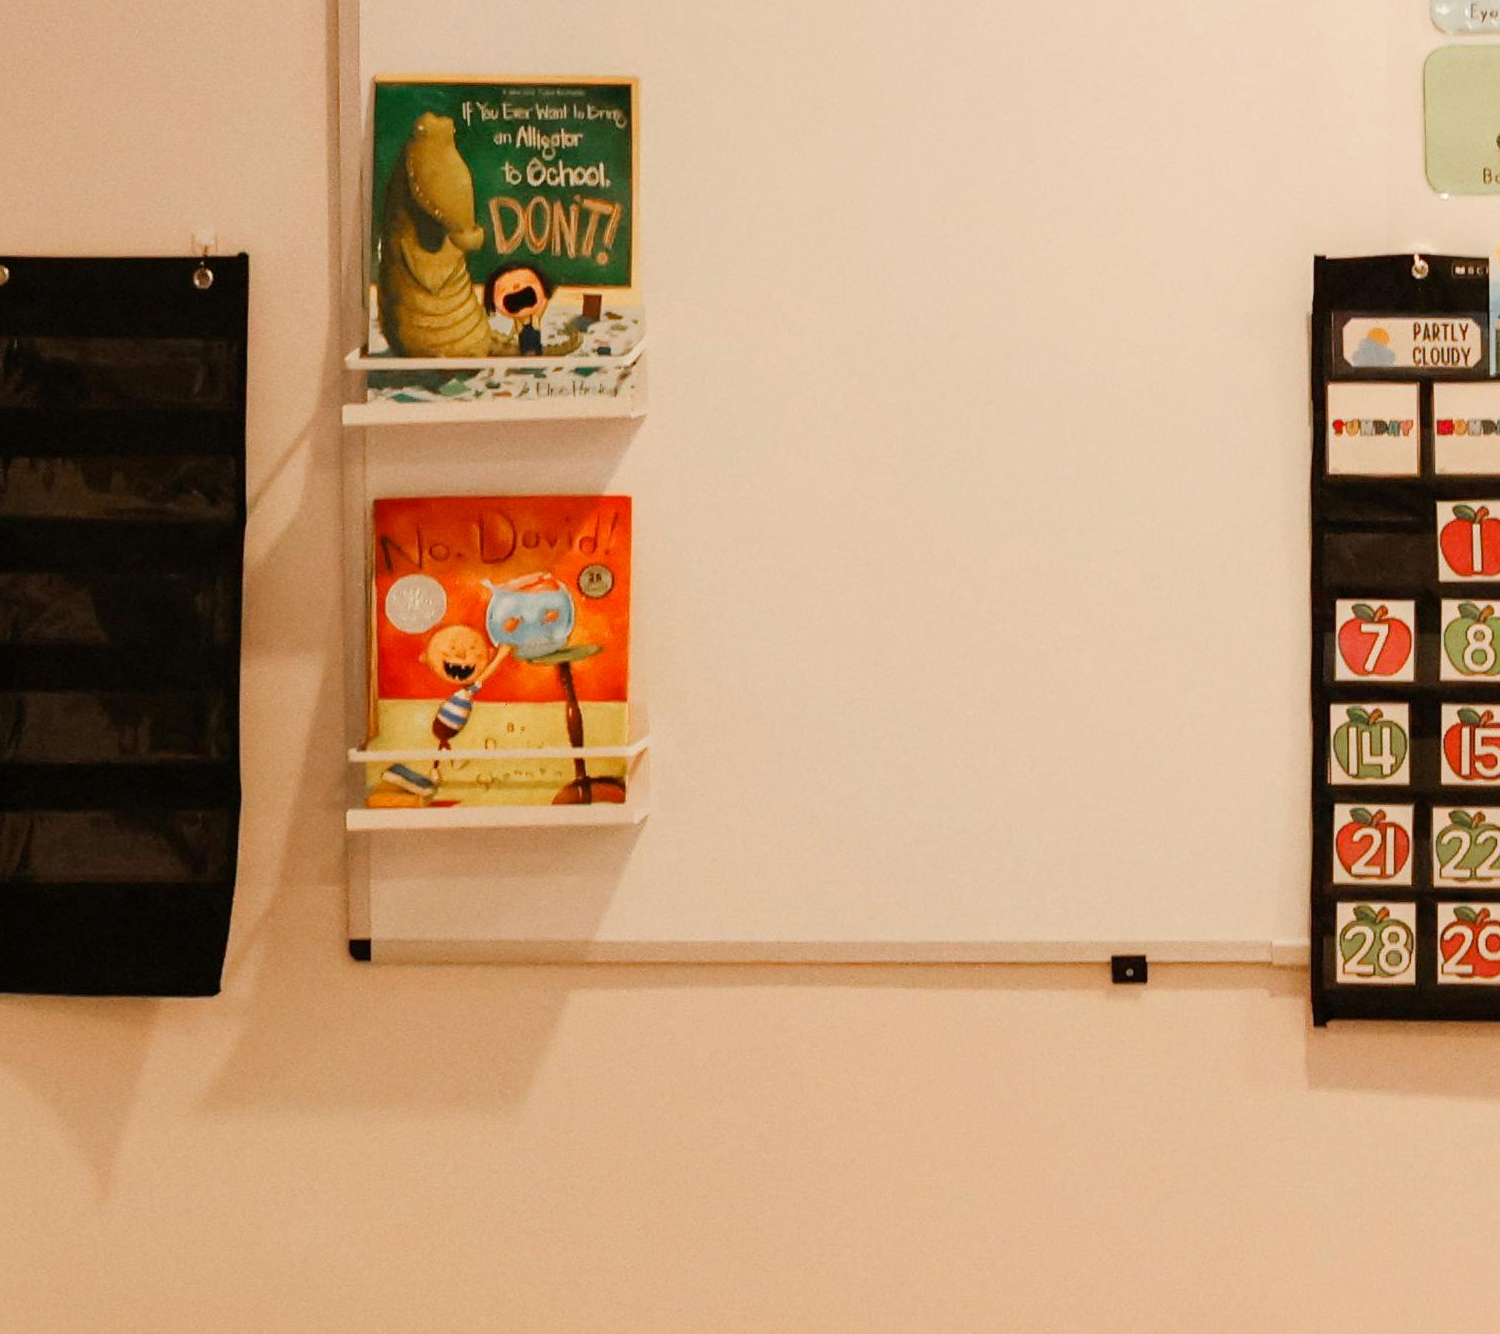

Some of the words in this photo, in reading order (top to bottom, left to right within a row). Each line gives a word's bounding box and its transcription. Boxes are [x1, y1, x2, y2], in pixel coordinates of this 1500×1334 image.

[493, 131, 512, 146] an
[515, 125, 584, 161] Alligator
[501, 161, 522, 186] to
[1412, 321, 1470, 343] PARTLY
[1411, 347, 1472, 367] CLOUDY
[1471, 523, 1483, 573] 1
[1360, 622, 1390, 673] 7
[1350, 826, 1396, 876] 21
[1343, 924, 1411, 975] 28
